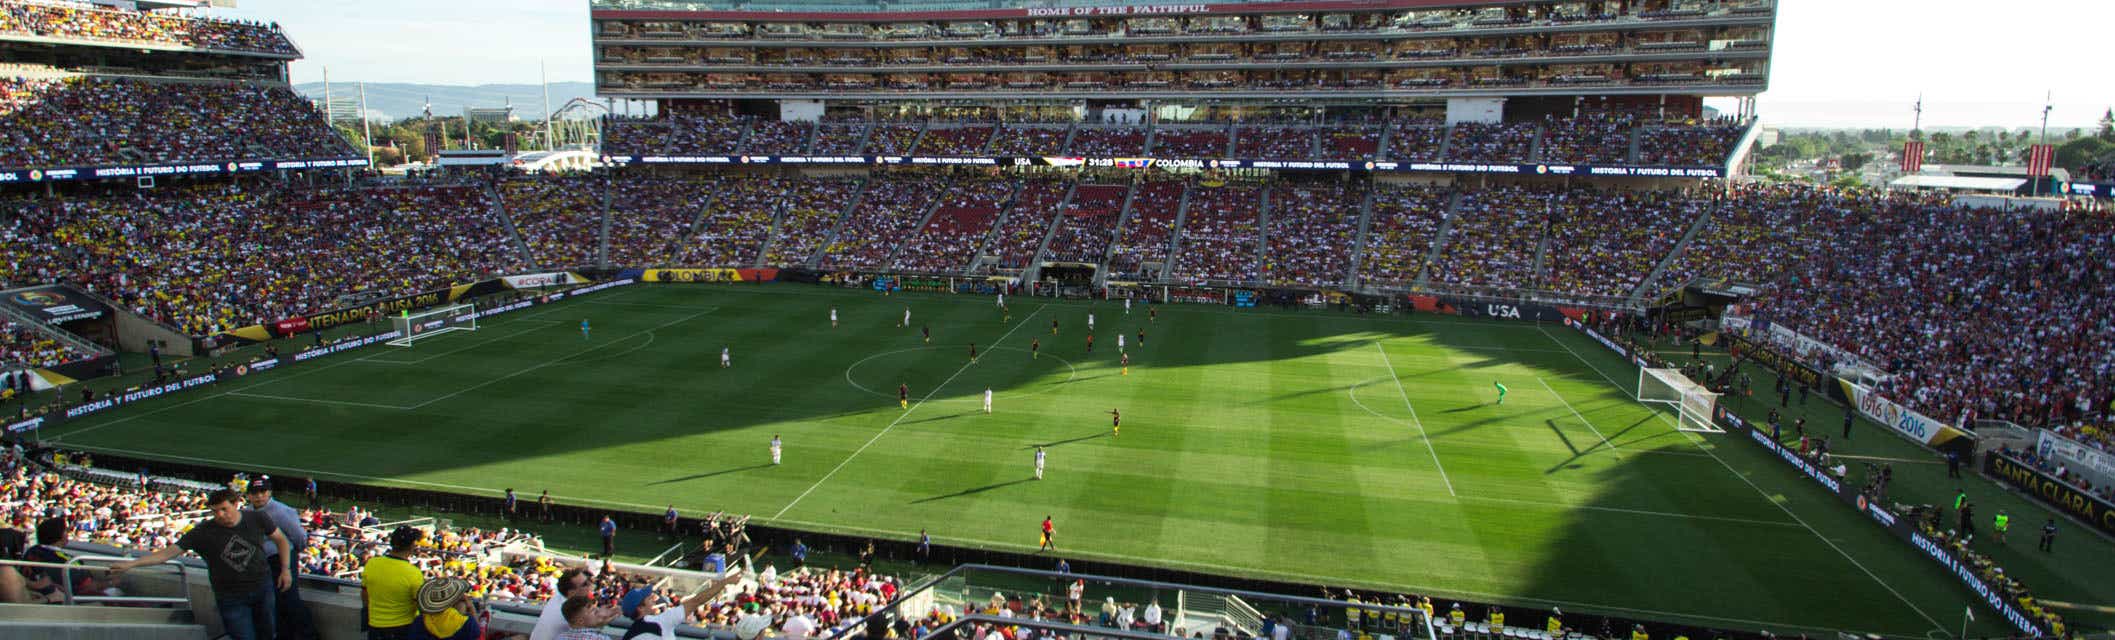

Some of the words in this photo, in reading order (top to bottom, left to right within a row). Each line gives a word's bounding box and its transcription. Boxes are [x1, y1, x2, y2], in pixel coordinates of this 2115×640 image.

[1028, 8, 1069, 16] HOME
[1098, 7, 1127, 15] THE
[1133, 5, 1209, 14] FAITHFUL
[1014, 158, 1031, 166] USA
[1088, 158, 1113, 167] 31:28
[1156, 159, 1204, 168] COLOMBIA
[143, 165, 174, 175] FUTURO
[1591, 167, 1627, 175] HISTORIA
[1686, 169, 1717, 177] FUTBOL
[1488, 304, 1521, 319] USA
[66, 399, 112, 418] HISTORIA
[114, 395, 122, 405] Y
[124, 386, 163, 403] FUTURO
[165, 381, 181, 392] DEL
[183, 373, 217, 388] FUTBOL
[1861, 394, 1882, 417] 1916
[1899, 410, 1926, 438] 2016
[1751, 428, 1776, 450] HISTORIA
[1781, 447, 1804, 470] FUTURO
[1804, 463, 1815, 478] DEL
[1815, 470, 1840, 494] FUTBOL
[1994, 458, 2039, 494] SANTA
[2043, 481, 2095, 519] CLARA
[1911, 532, 1951, 567] HISTÓRIA
[1952, 560, 1959, 573] E
[1959, 565, 1988, 598] FUTURO
[1988, 591, 2002, 610] DO
